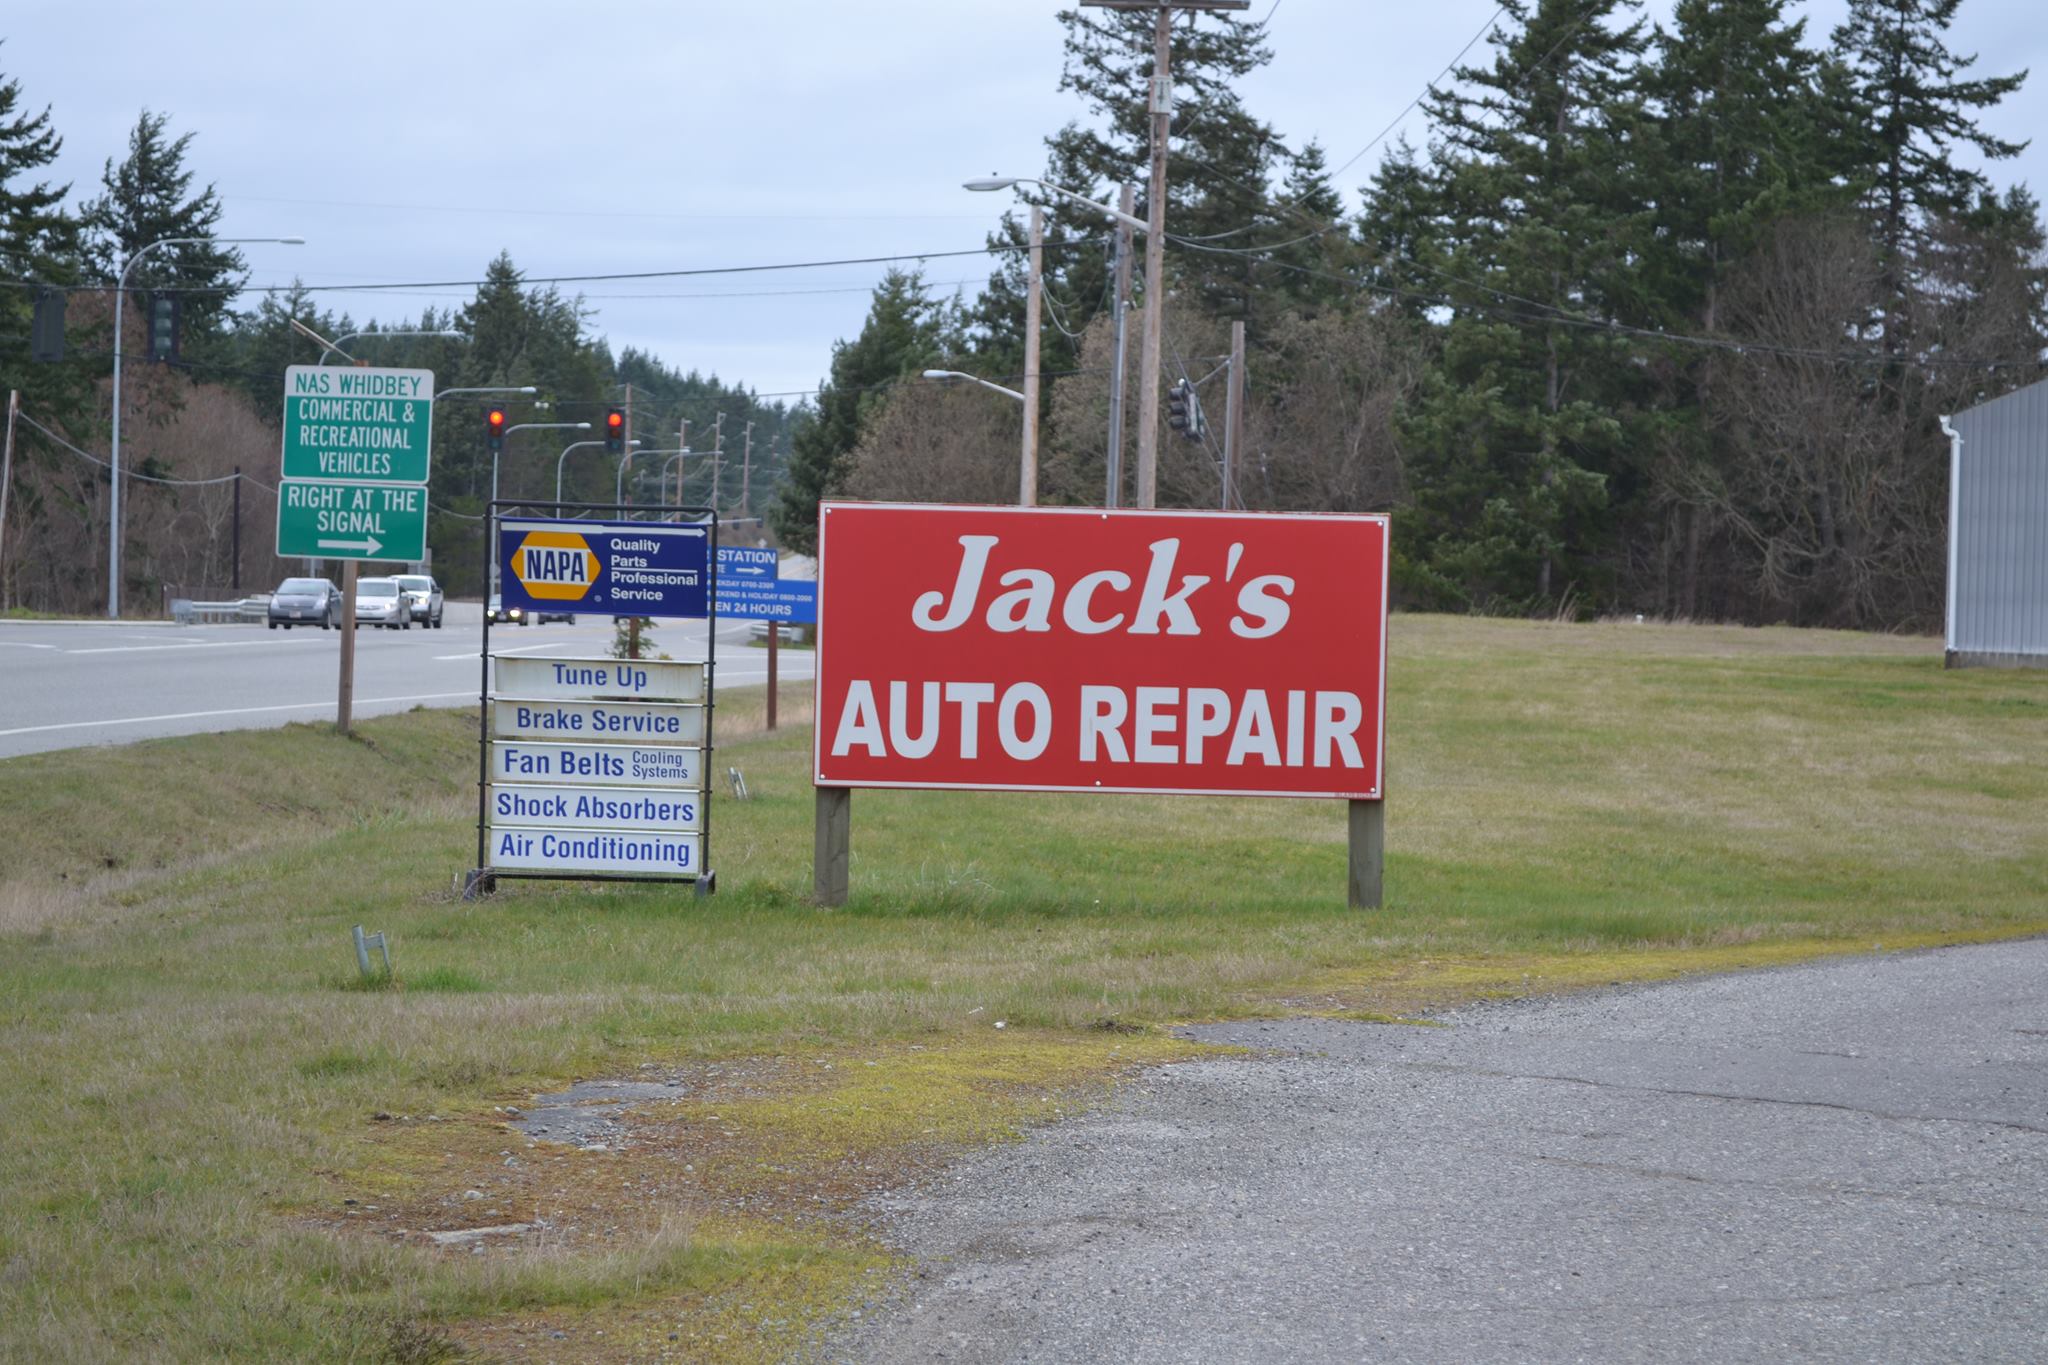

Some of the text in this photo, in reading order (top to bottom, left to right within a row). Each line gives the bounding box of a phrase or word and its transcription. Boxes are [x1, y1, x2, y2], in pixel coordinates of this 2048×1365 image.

[296, 373, 421, 397] NAS WHIDBEY
[299, 398, 415, 422] COMMERCIAL &
[300, 425, 411, 449] RECREATIONAL
[319, 452, 391, 474] VEHICLES
[288, 486, 418, 512] RIGHT AT THE
[317, 510, 386, 534] SIGNAL
[610, 538, 660, 555] Quality
[716, 549, 777, 564] STATION
[526, 549, 585, 582] NAPA
[611, 554, 647, 568] Parts
[611, 571, 698, 586] Professional
[911, 535, 1296, 639] Jack's
[611, 587, 663, 601] Service
[734, 603, 747, 613] 24
[750, 603, 793, 616] HOURS
[552, 663, 647, 691] Tune Up
[517, 707, 680, 733] Brake Service
[831, 679, 1365, 769] AUTO REPAIR
[504, 749, 624, 777] Fan Belts
[632, 750, 682, 767] Cooling
[632, 764, 688, 780] Systems
[497, 793, 694, 822] Shock Absorbers
[499, 833, 690, 867] Air Conditioning
